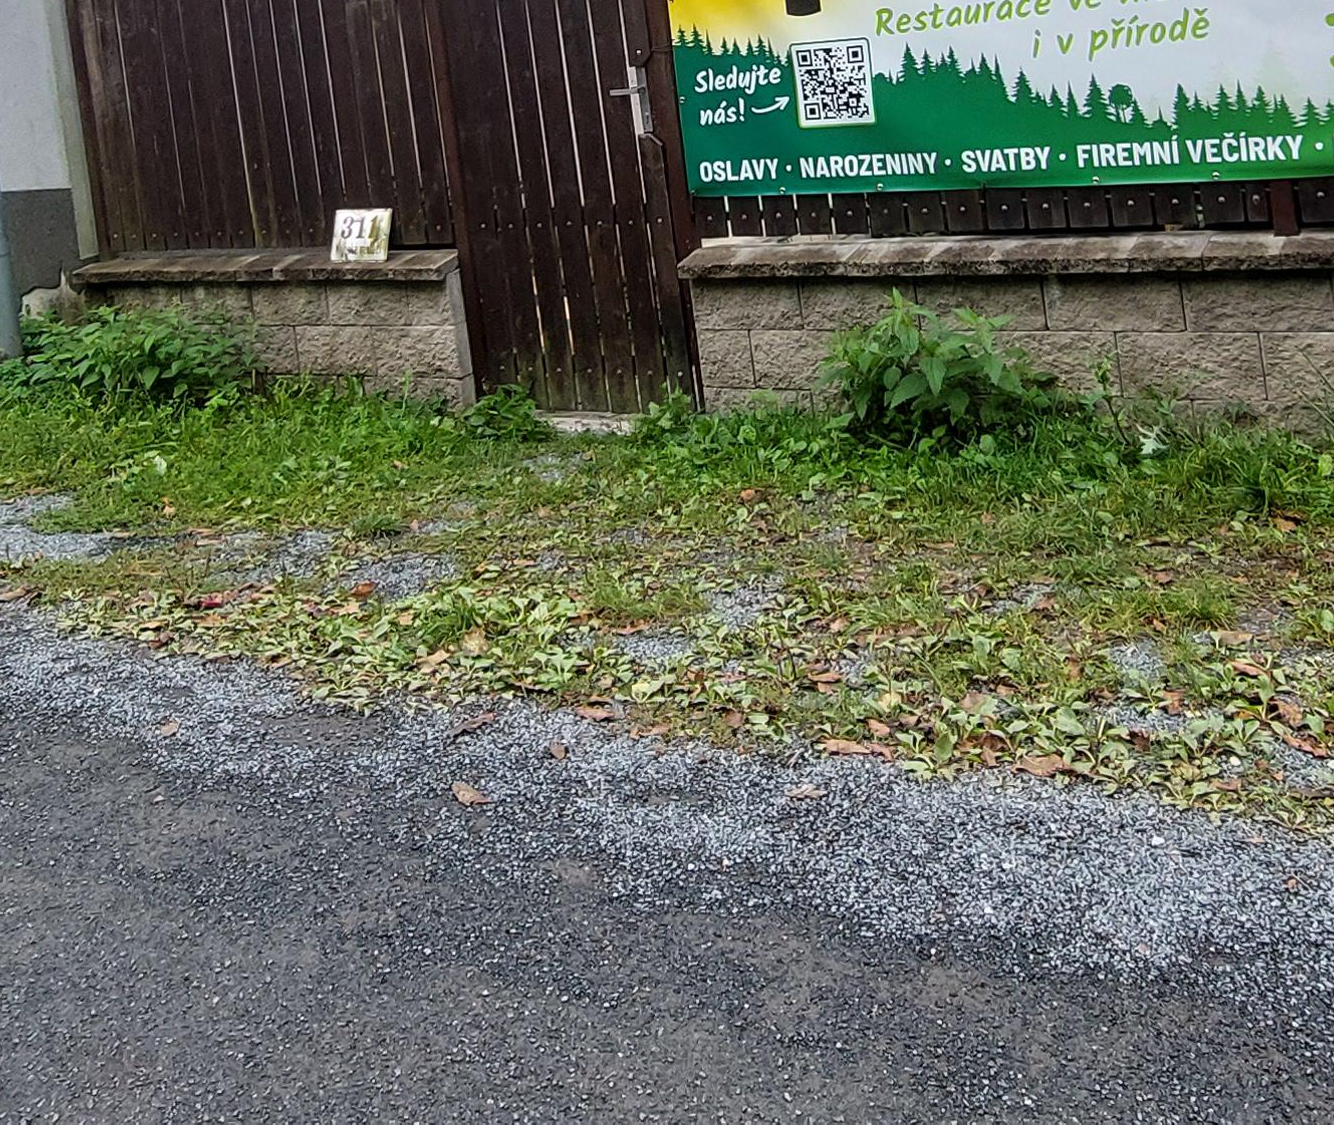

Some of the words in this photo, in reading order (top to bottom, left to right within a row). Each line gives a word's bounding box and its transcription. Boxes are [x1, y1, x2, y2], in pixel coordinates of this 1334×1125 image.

[1032, 29, 1043, 58] i
[1057, 30, 1074, 55] v
[1088, 13, 1211, 61] přírodě
[694, 64, 781, 95] Sledujte
[699, 98, 745, 126] nás!
[699, 158, 778, 182] OSLAVY
[799, 152, 937, 178] NAROZENINY
[961, 146, 1051, 173] SVATBY
[1076, 134, 1180, 168] FIREMNÍ
[1185, 130, 1303, 162] VEČÍRKY
